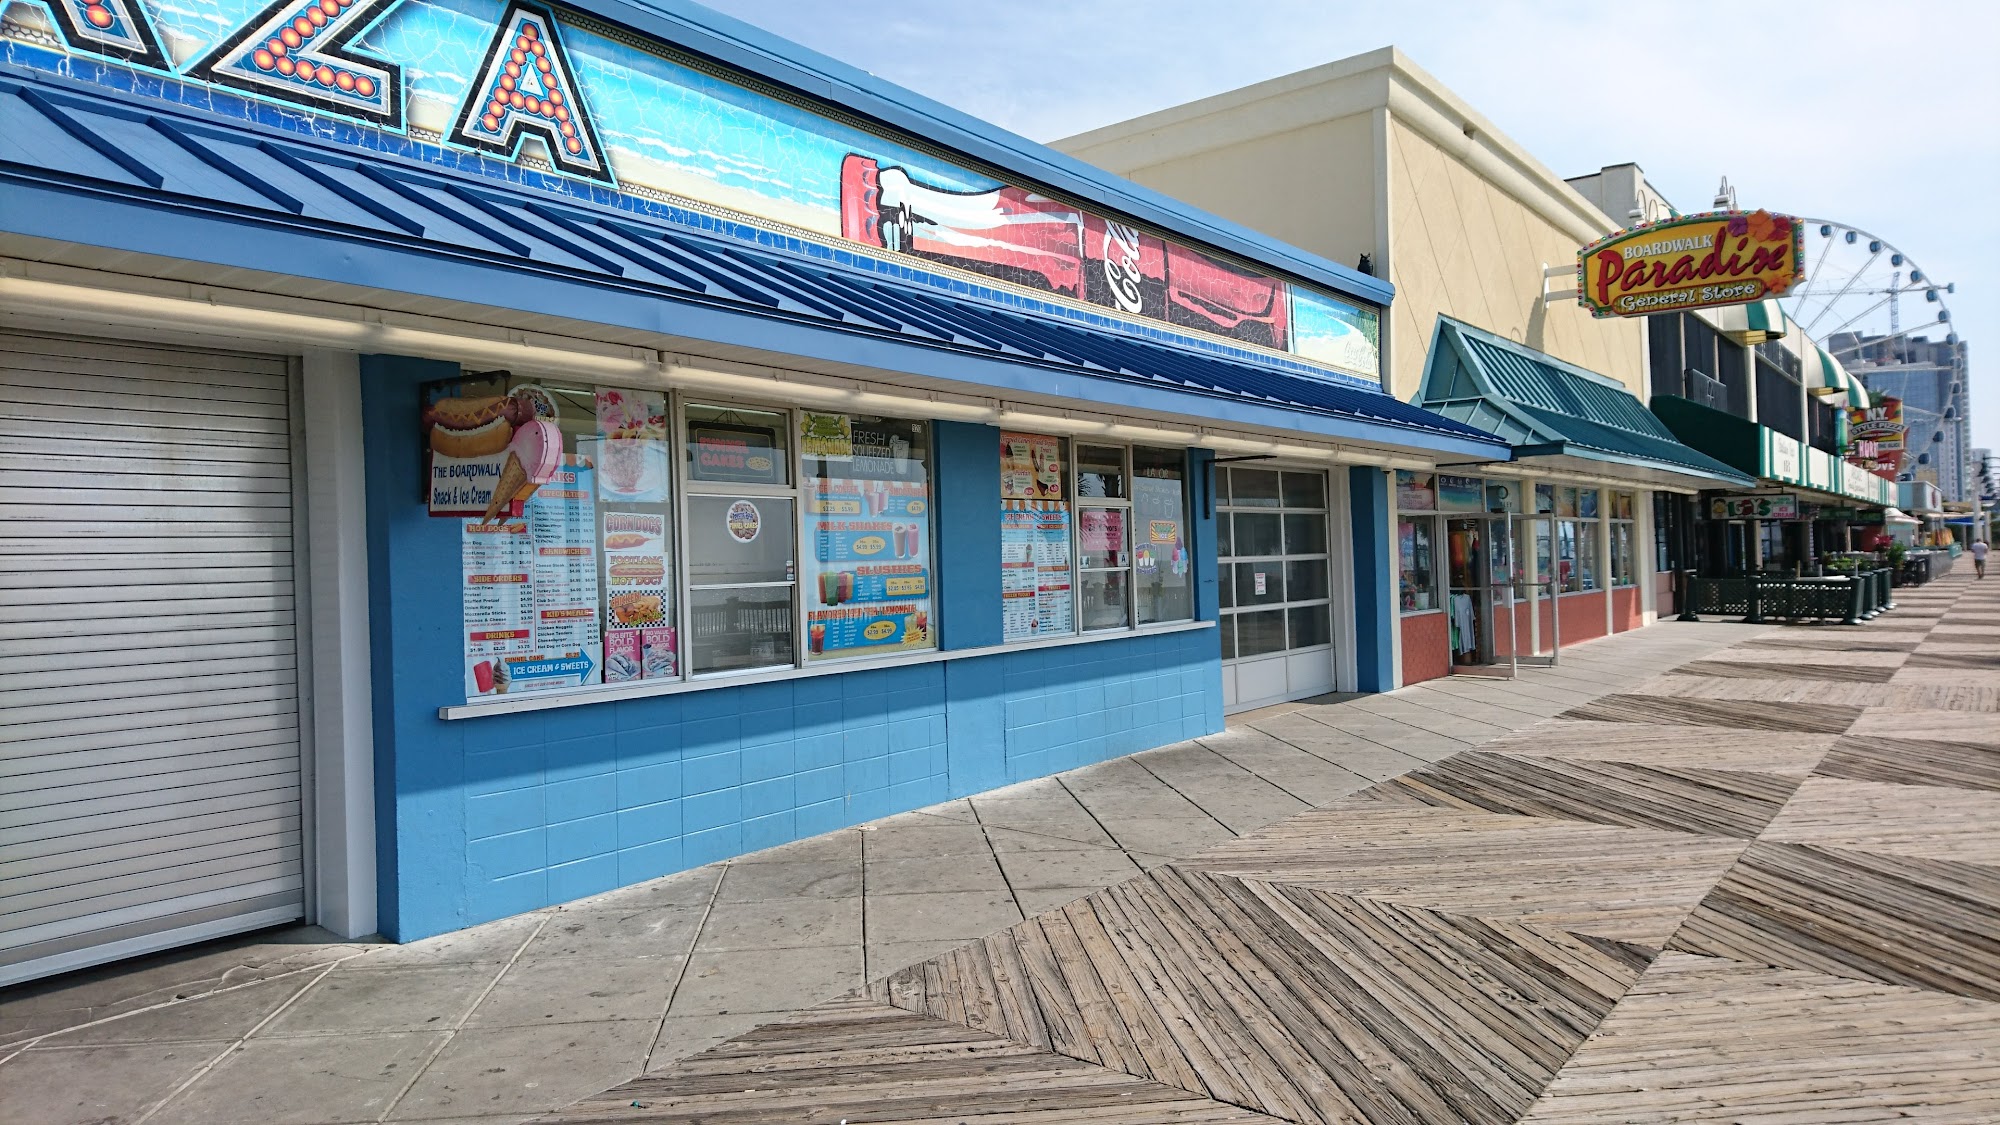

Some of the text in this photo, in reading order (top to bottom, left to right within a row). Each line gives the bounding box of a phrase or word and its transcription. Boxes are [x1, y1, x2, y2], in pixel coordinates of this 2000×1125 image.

[0, 0, 617, 189] ZA
[1623, 234, 1713, 260] BOARDWALK
[1597, 226, 1789, 306] Paradise
[1620, 284, 1756, 311] General Store
[1851, 422, 1905, 435] STYLE PIZZA
[699, 436, 750, 454] FUNNEL
[852, 430, 886, 446] FRESH
[800, 436, 852, 457] LEMONADE
[852, 444, 891, 459] SQUEEZED
[700, 453, 745, 469] CAKES
[852, 459, 895, 475] LEMONADE
[433, 463, 501, 481] THE BOARDWALK
[433, 487, 451, 505] Snack
[460, 487, 469, 504] Ice
[471, 486, 491, 504] Cream
[1041, 513, 1062, 521] SWEETS
[605, 514, 662, 536] CORN DOGS
[816, 521, 893, 532] MILK SHAKES
[609, 555, 664, 565] FOOTLONG
[856, 564, 922, 576] SLUSHIES
[611, 576, 633, 586] HOT
[610, 591, 641, 608] CHICKEN
[566, 609, 589, 617] MEALS
[808, 609, 846, 620] FLAVORED
[485, 631, 515, 639] DRINKS
[609, 637, 634, 647] BOLD
[646, 634, 670, 644] BOLD
[513, 666, 526, 675] ICE
[526, 664, 554, 674] CREAM
[560, 661, 589, 671] SWEETS
